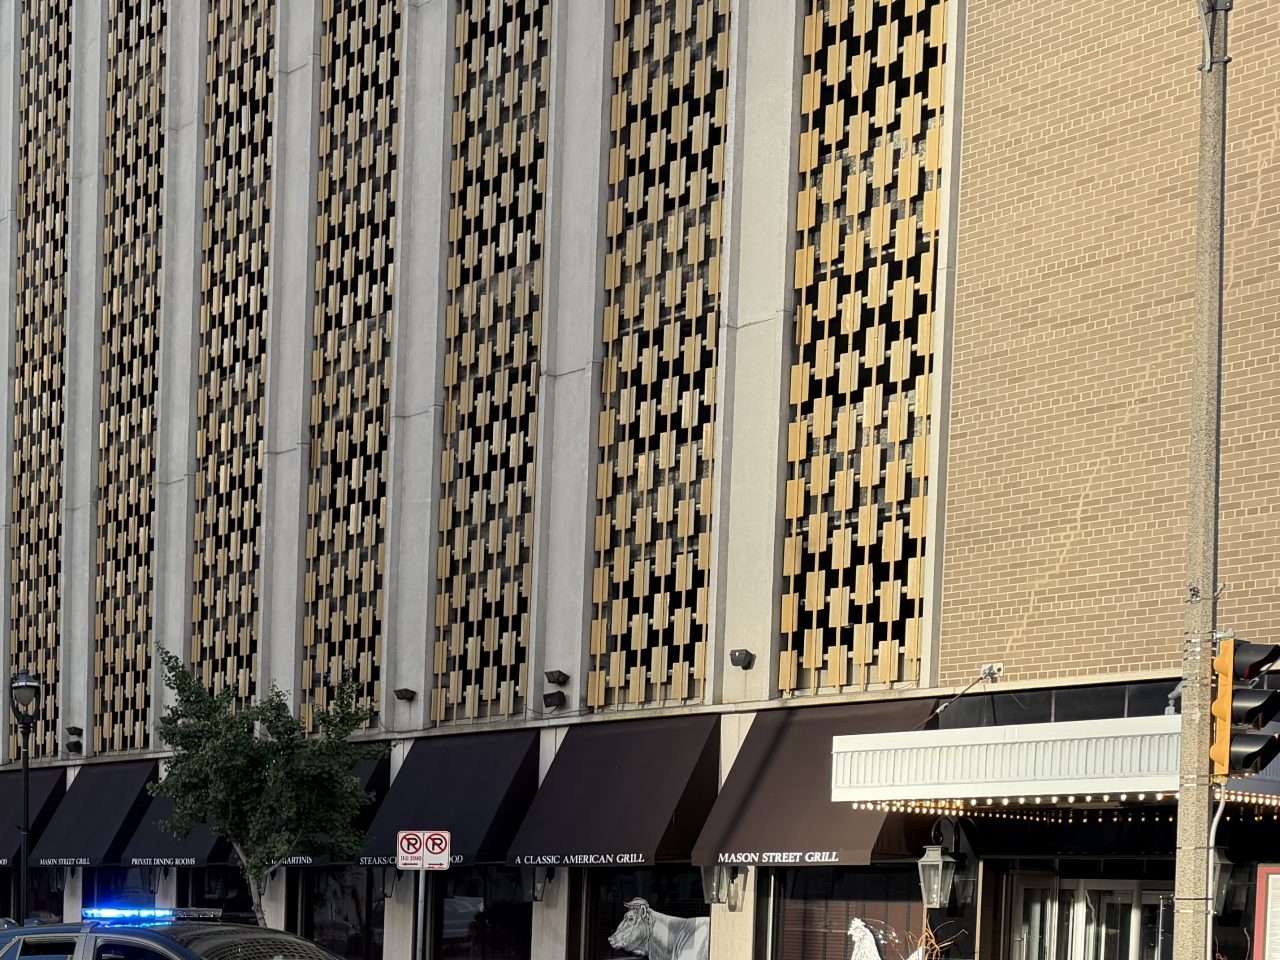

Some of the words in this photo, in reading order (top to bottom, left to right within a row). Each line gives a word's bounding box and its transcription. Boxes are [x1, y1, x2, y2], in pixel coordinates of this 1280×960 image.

[175, 857, 195, 865] ROOMS
[515, 856, 521, 864] A
[524, 855, 560, 864] CLASSIC
[563, 854, 613, 864] AMERICAN
[616, 853, 645, 863] GRILL
[718, 853, 759, 863] MASON
[762, 852, 802, 863] STREET
[804, 852, 839, 862] GRILL
